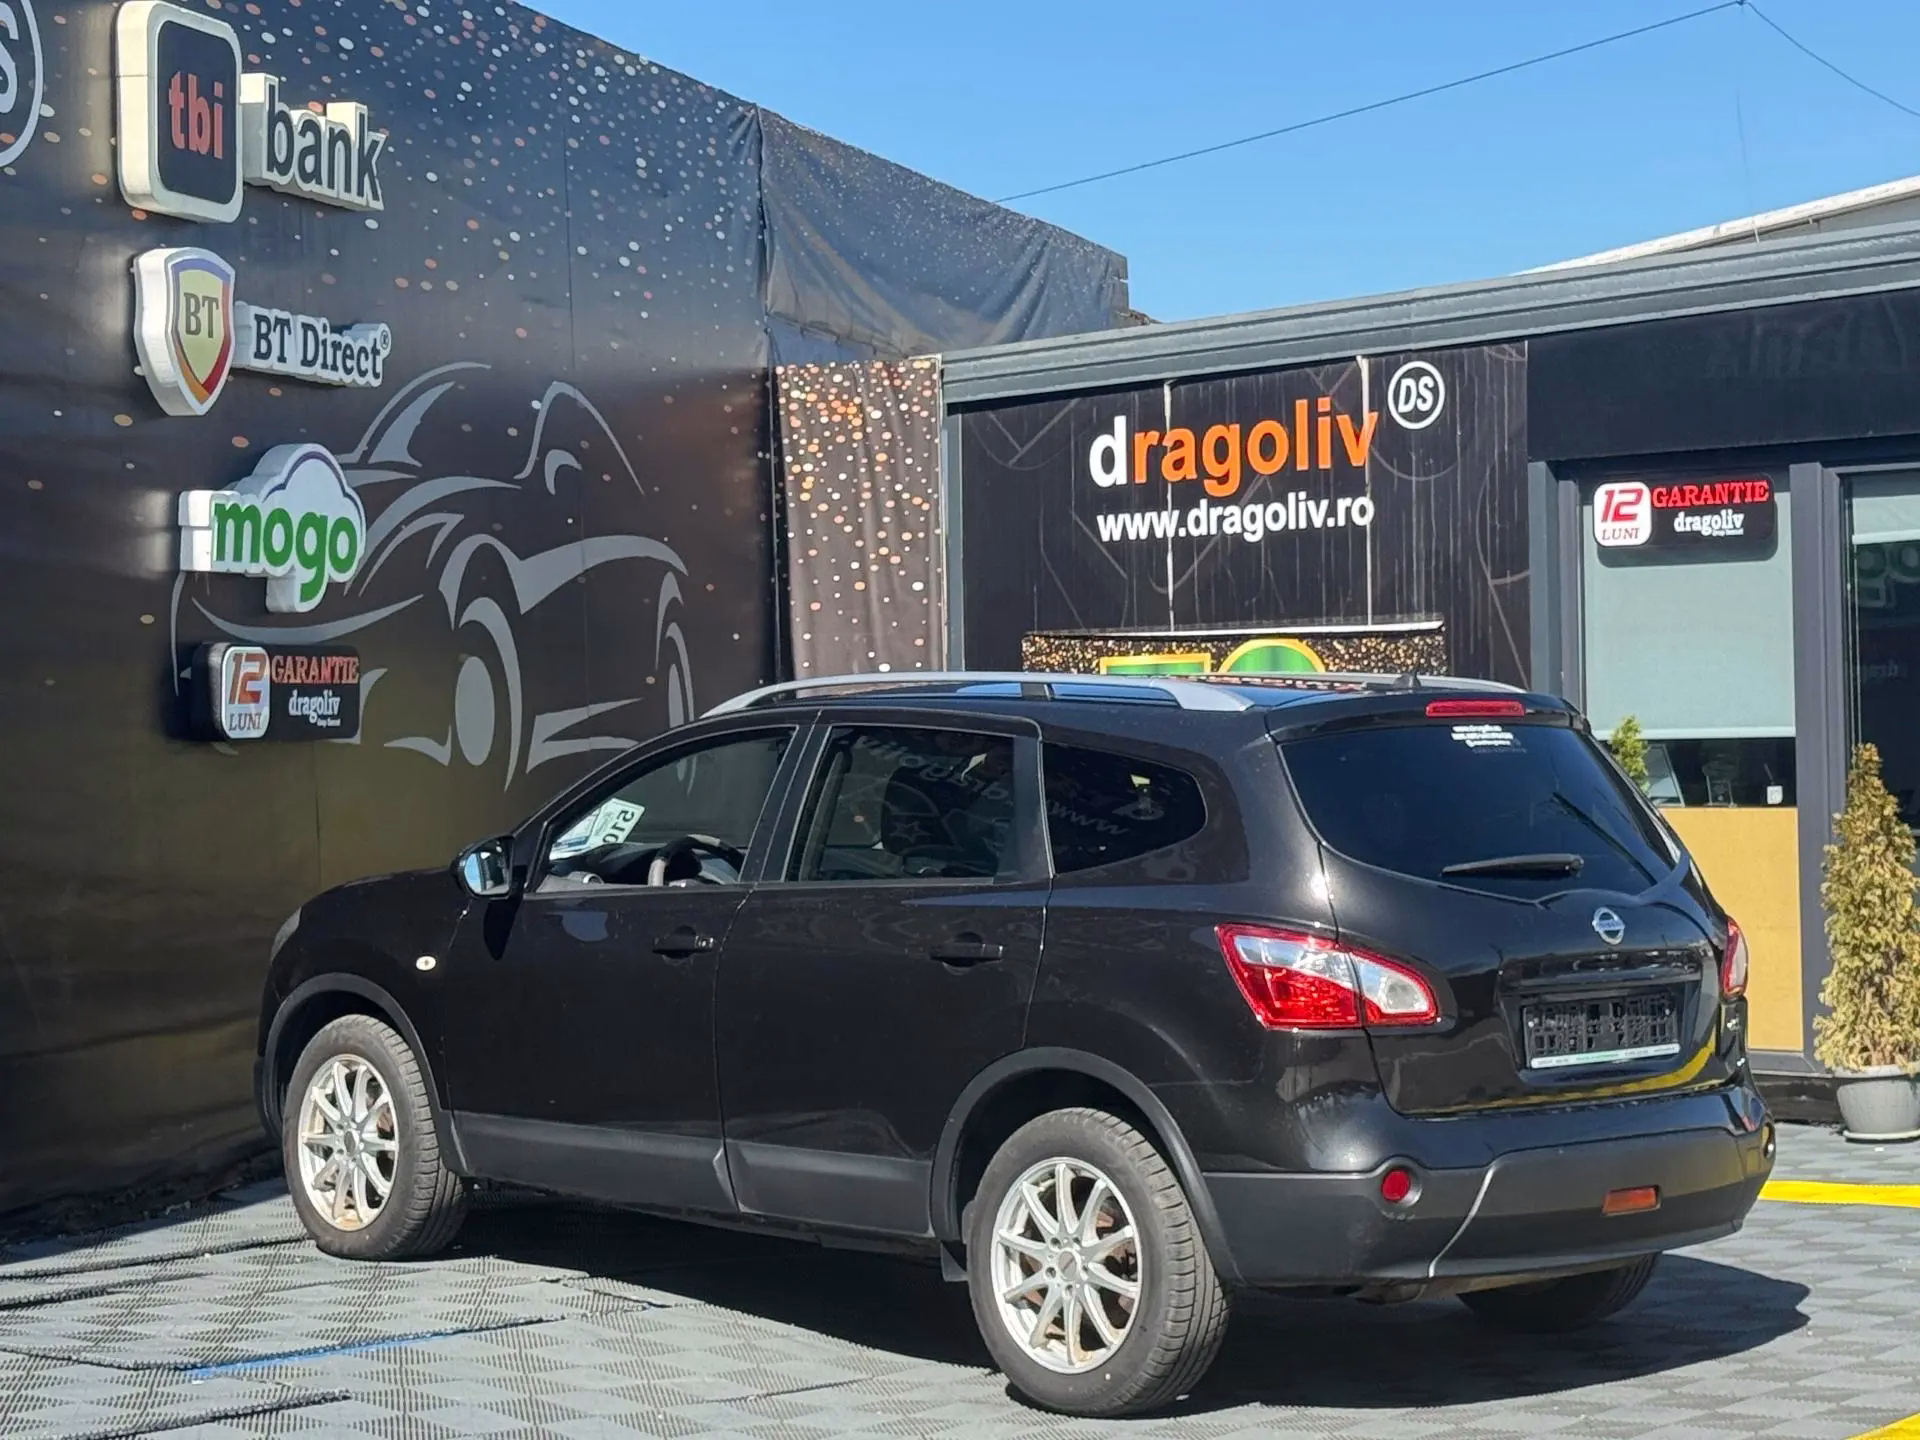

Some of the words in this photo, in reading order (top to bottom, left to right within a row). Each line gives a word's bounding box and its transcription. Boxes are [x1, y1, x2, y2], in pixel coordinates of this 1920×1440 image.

[168, 71, 223, 159] tbi
[267, 84, 383, 201] bank
[183, 292, 219, 338] BT
[253, 313, 292, 364] BT
[1398, 375, 1434, 413] DS
[1089, 395, 1379, 498] dragoliv
[1601, 488, 1643, 523] 12
[1652, 480, 1770, 508] GARANTIE
[1097, 491, 1375, 542] www.dragoliv.ro
[1602, 527, 1640, 541] LUNI
[1674, 508, 1745, 536] dragoliv
[214, 503, 358, 603] mogo
[228, 653, 267, 704] 12
[271, 655, 360, 684] GARANTIE
[229, 712, 263, 732] LUNI
[288, 688, 341, 724] dragoliv
